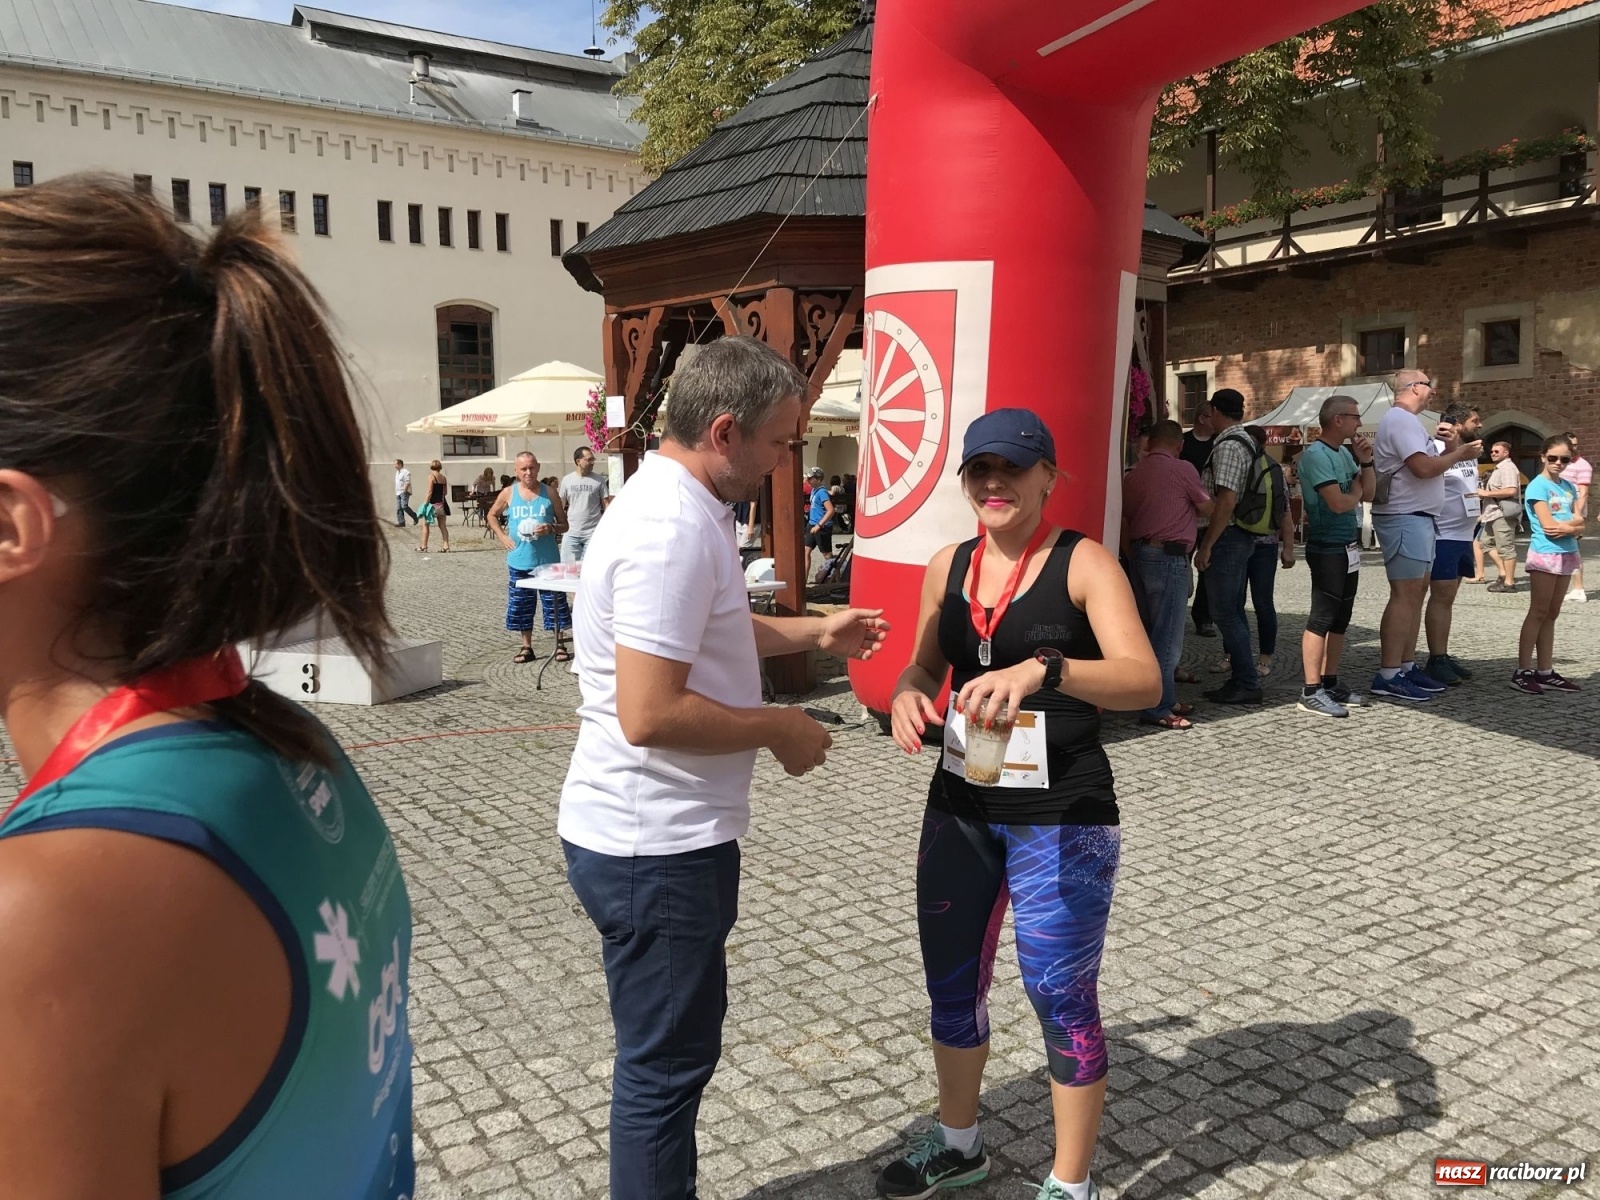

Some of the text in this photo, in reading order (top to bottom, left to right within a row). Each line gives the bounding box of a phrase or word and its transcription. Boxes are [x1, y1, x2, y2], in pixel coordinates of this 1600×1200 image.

[1461, 469, 1474, 478] TEAM
[579, 484, 593, 492] STAR
[512, 505, 547, 518] UCLA
[301, 663, 321, 694] 3
